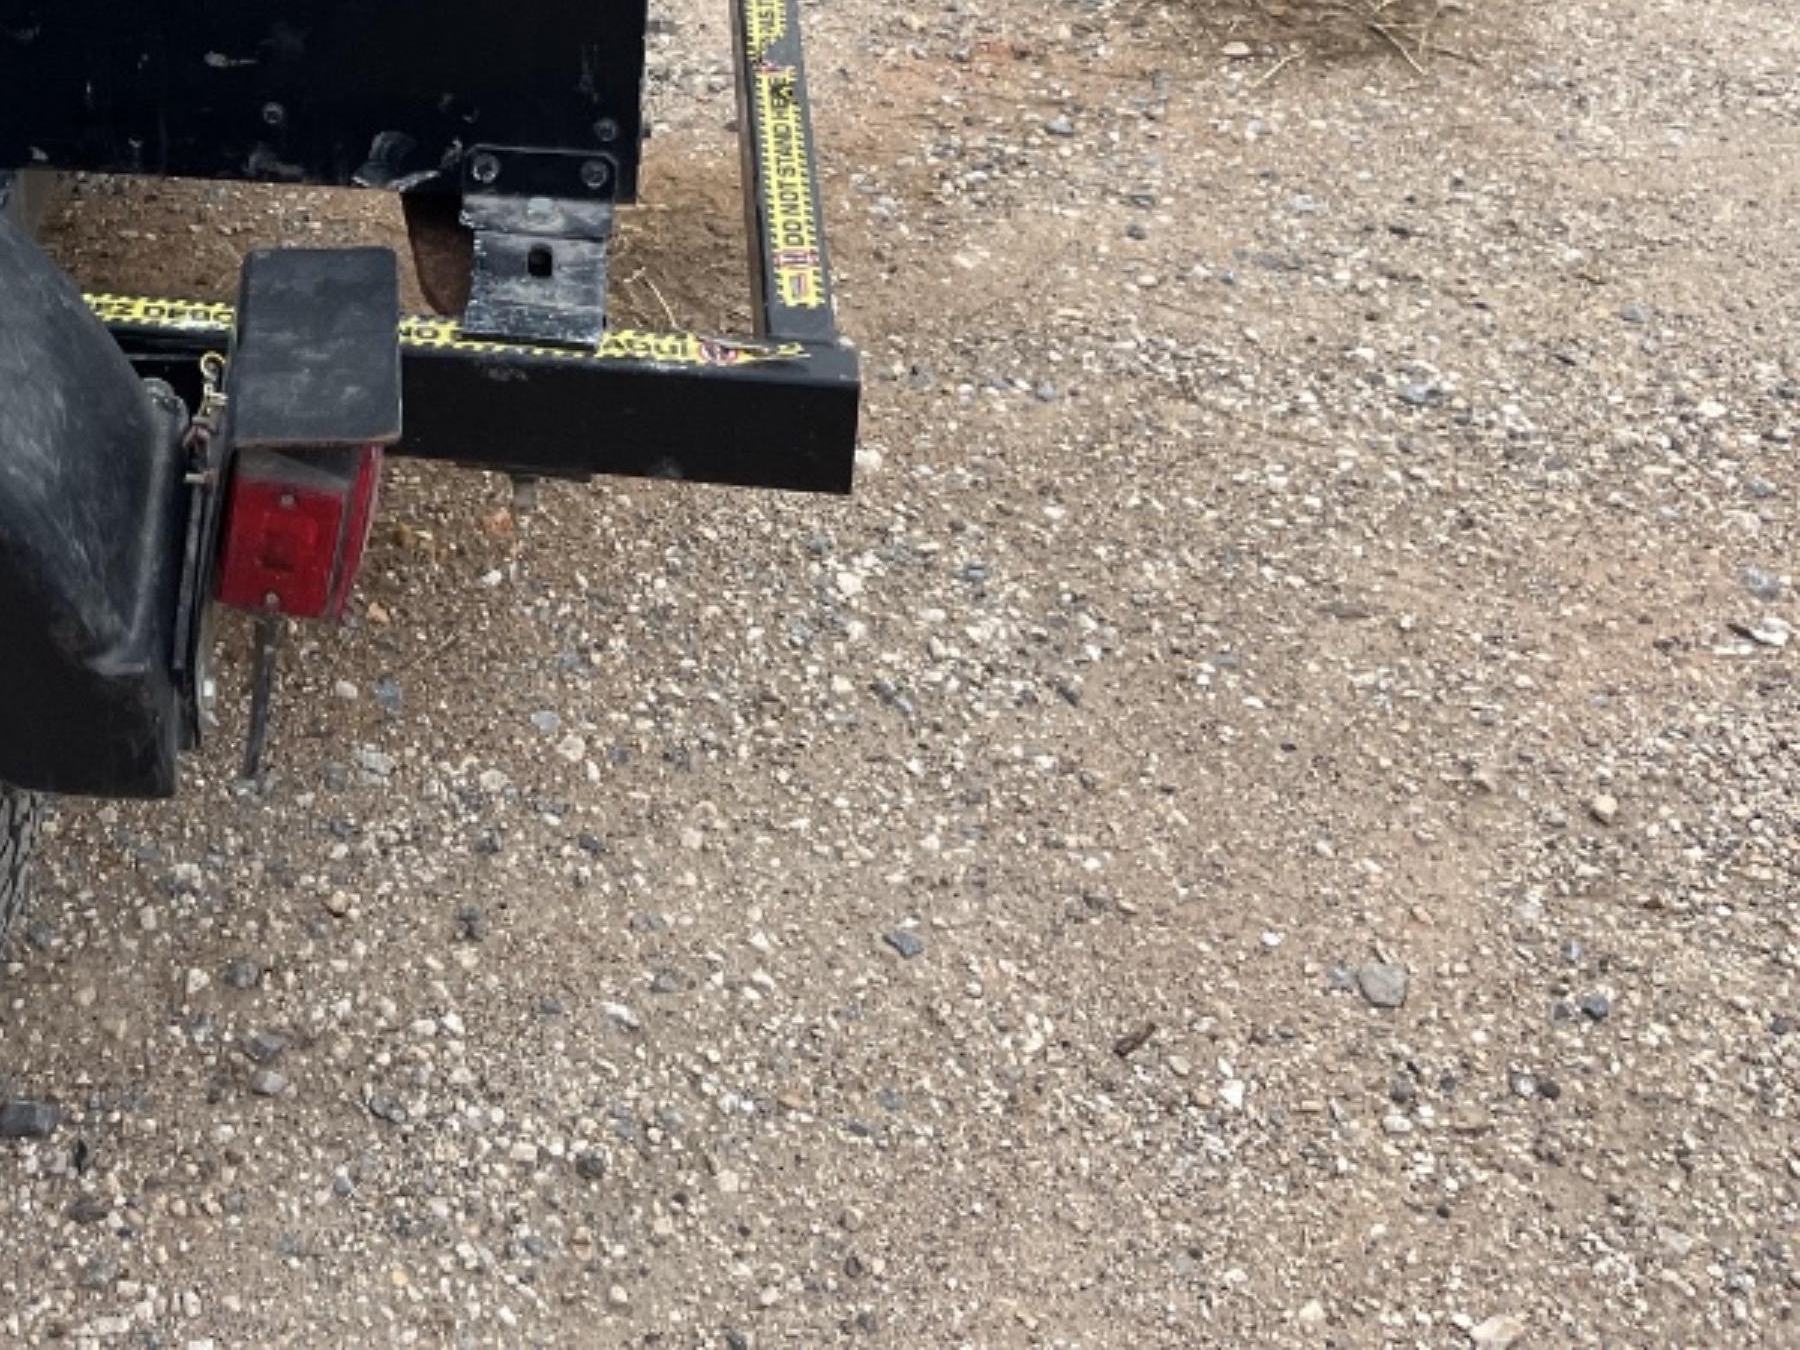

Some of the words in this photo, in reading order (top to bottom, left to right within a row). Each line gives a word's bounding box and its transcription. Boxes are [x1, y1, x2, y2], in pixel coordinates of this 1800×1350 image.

[773, 122, 797, 178] STAND
[778, 182, 800, 219] NOT
[782, 221, 804, 247] DO
